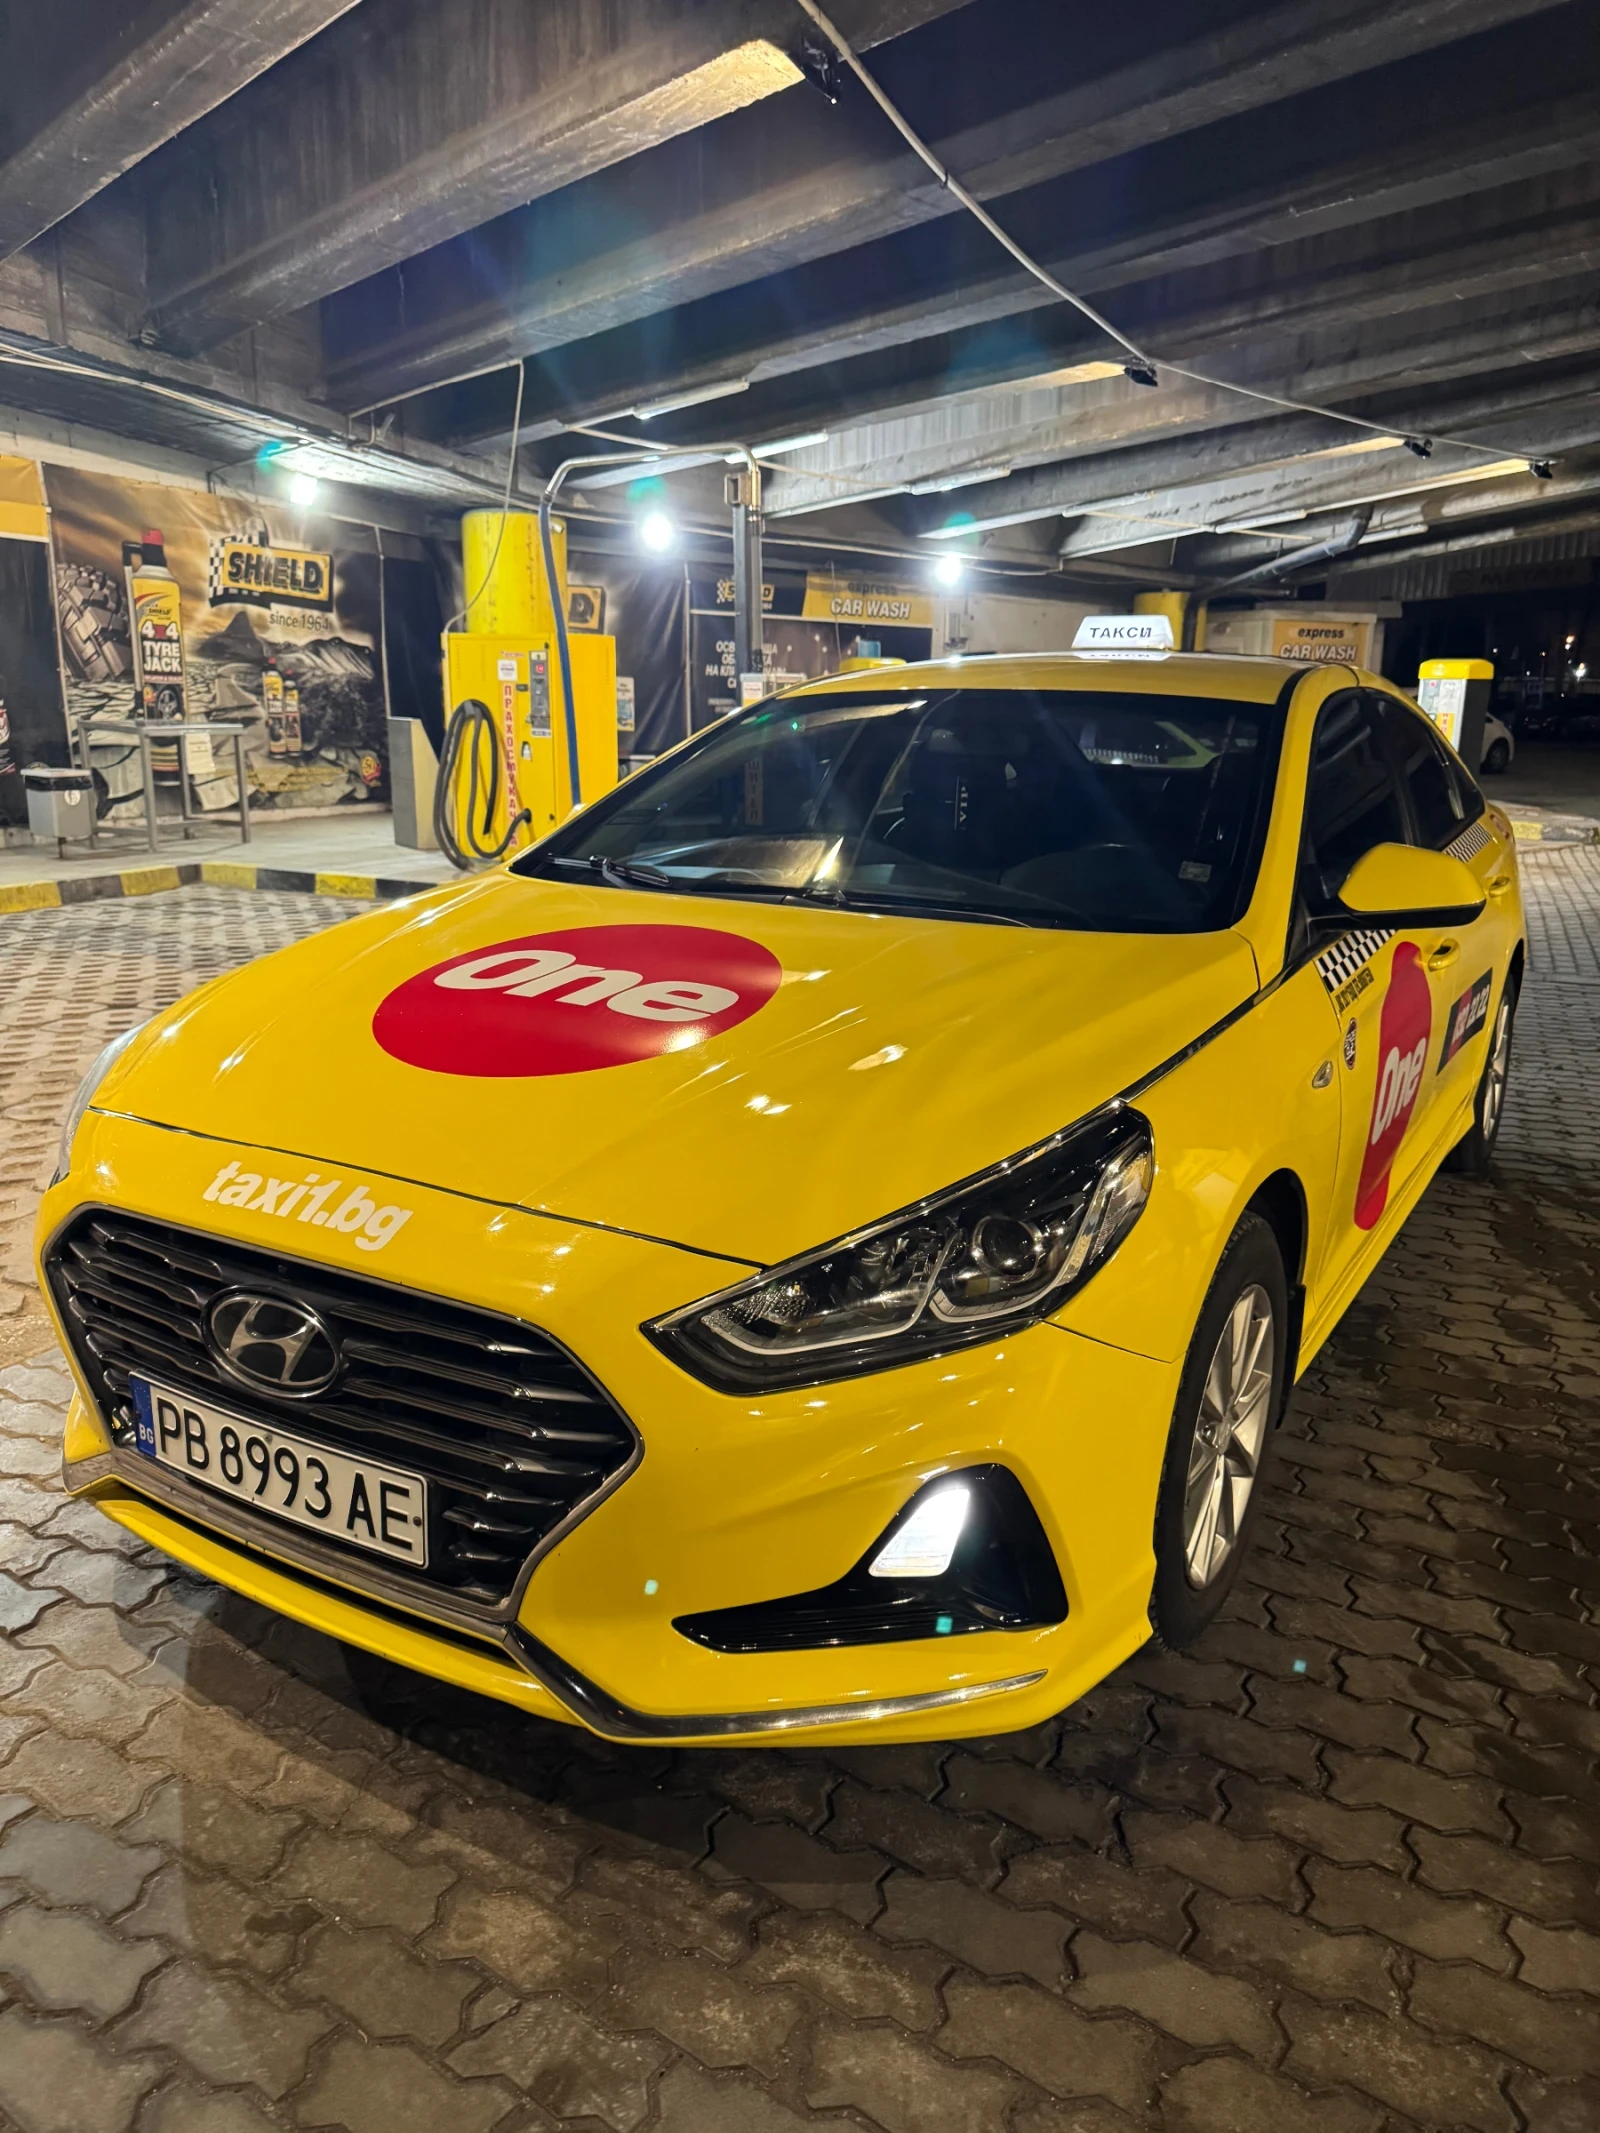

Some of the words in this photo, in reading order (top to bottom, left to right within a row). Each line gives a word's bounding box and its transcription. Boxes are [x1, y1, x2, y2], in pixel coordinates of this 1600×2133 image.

[228, 551, 323, 592] SHIELD
[831, 597, 864, 615] CAR
[866, 600, 911, 619] WASH
[269, 610, 299, 626] since
[300, 614, 330, 631] 1964
[1089, 627, 1153, 639] ТАКСИ
[1298, 628, 1345, 640] express
[142, 641, 181, 657] TYRE
[1280, 644, 1312, 660] CAR
[1314, 645, 1357, 661] WASH
[143, 656, 182, 672] JACK
[503, 685, 517, 845] ПРАХОСМУКАЧА
[202, 1161, 414, 1251] taxi1.bg
[139, 1422, 154, 1445] BG
[157, 1396, 210, 1471] PB
[220, 1425, 333, 1519] 8993
[346, 1471, 413, 1552] AE
